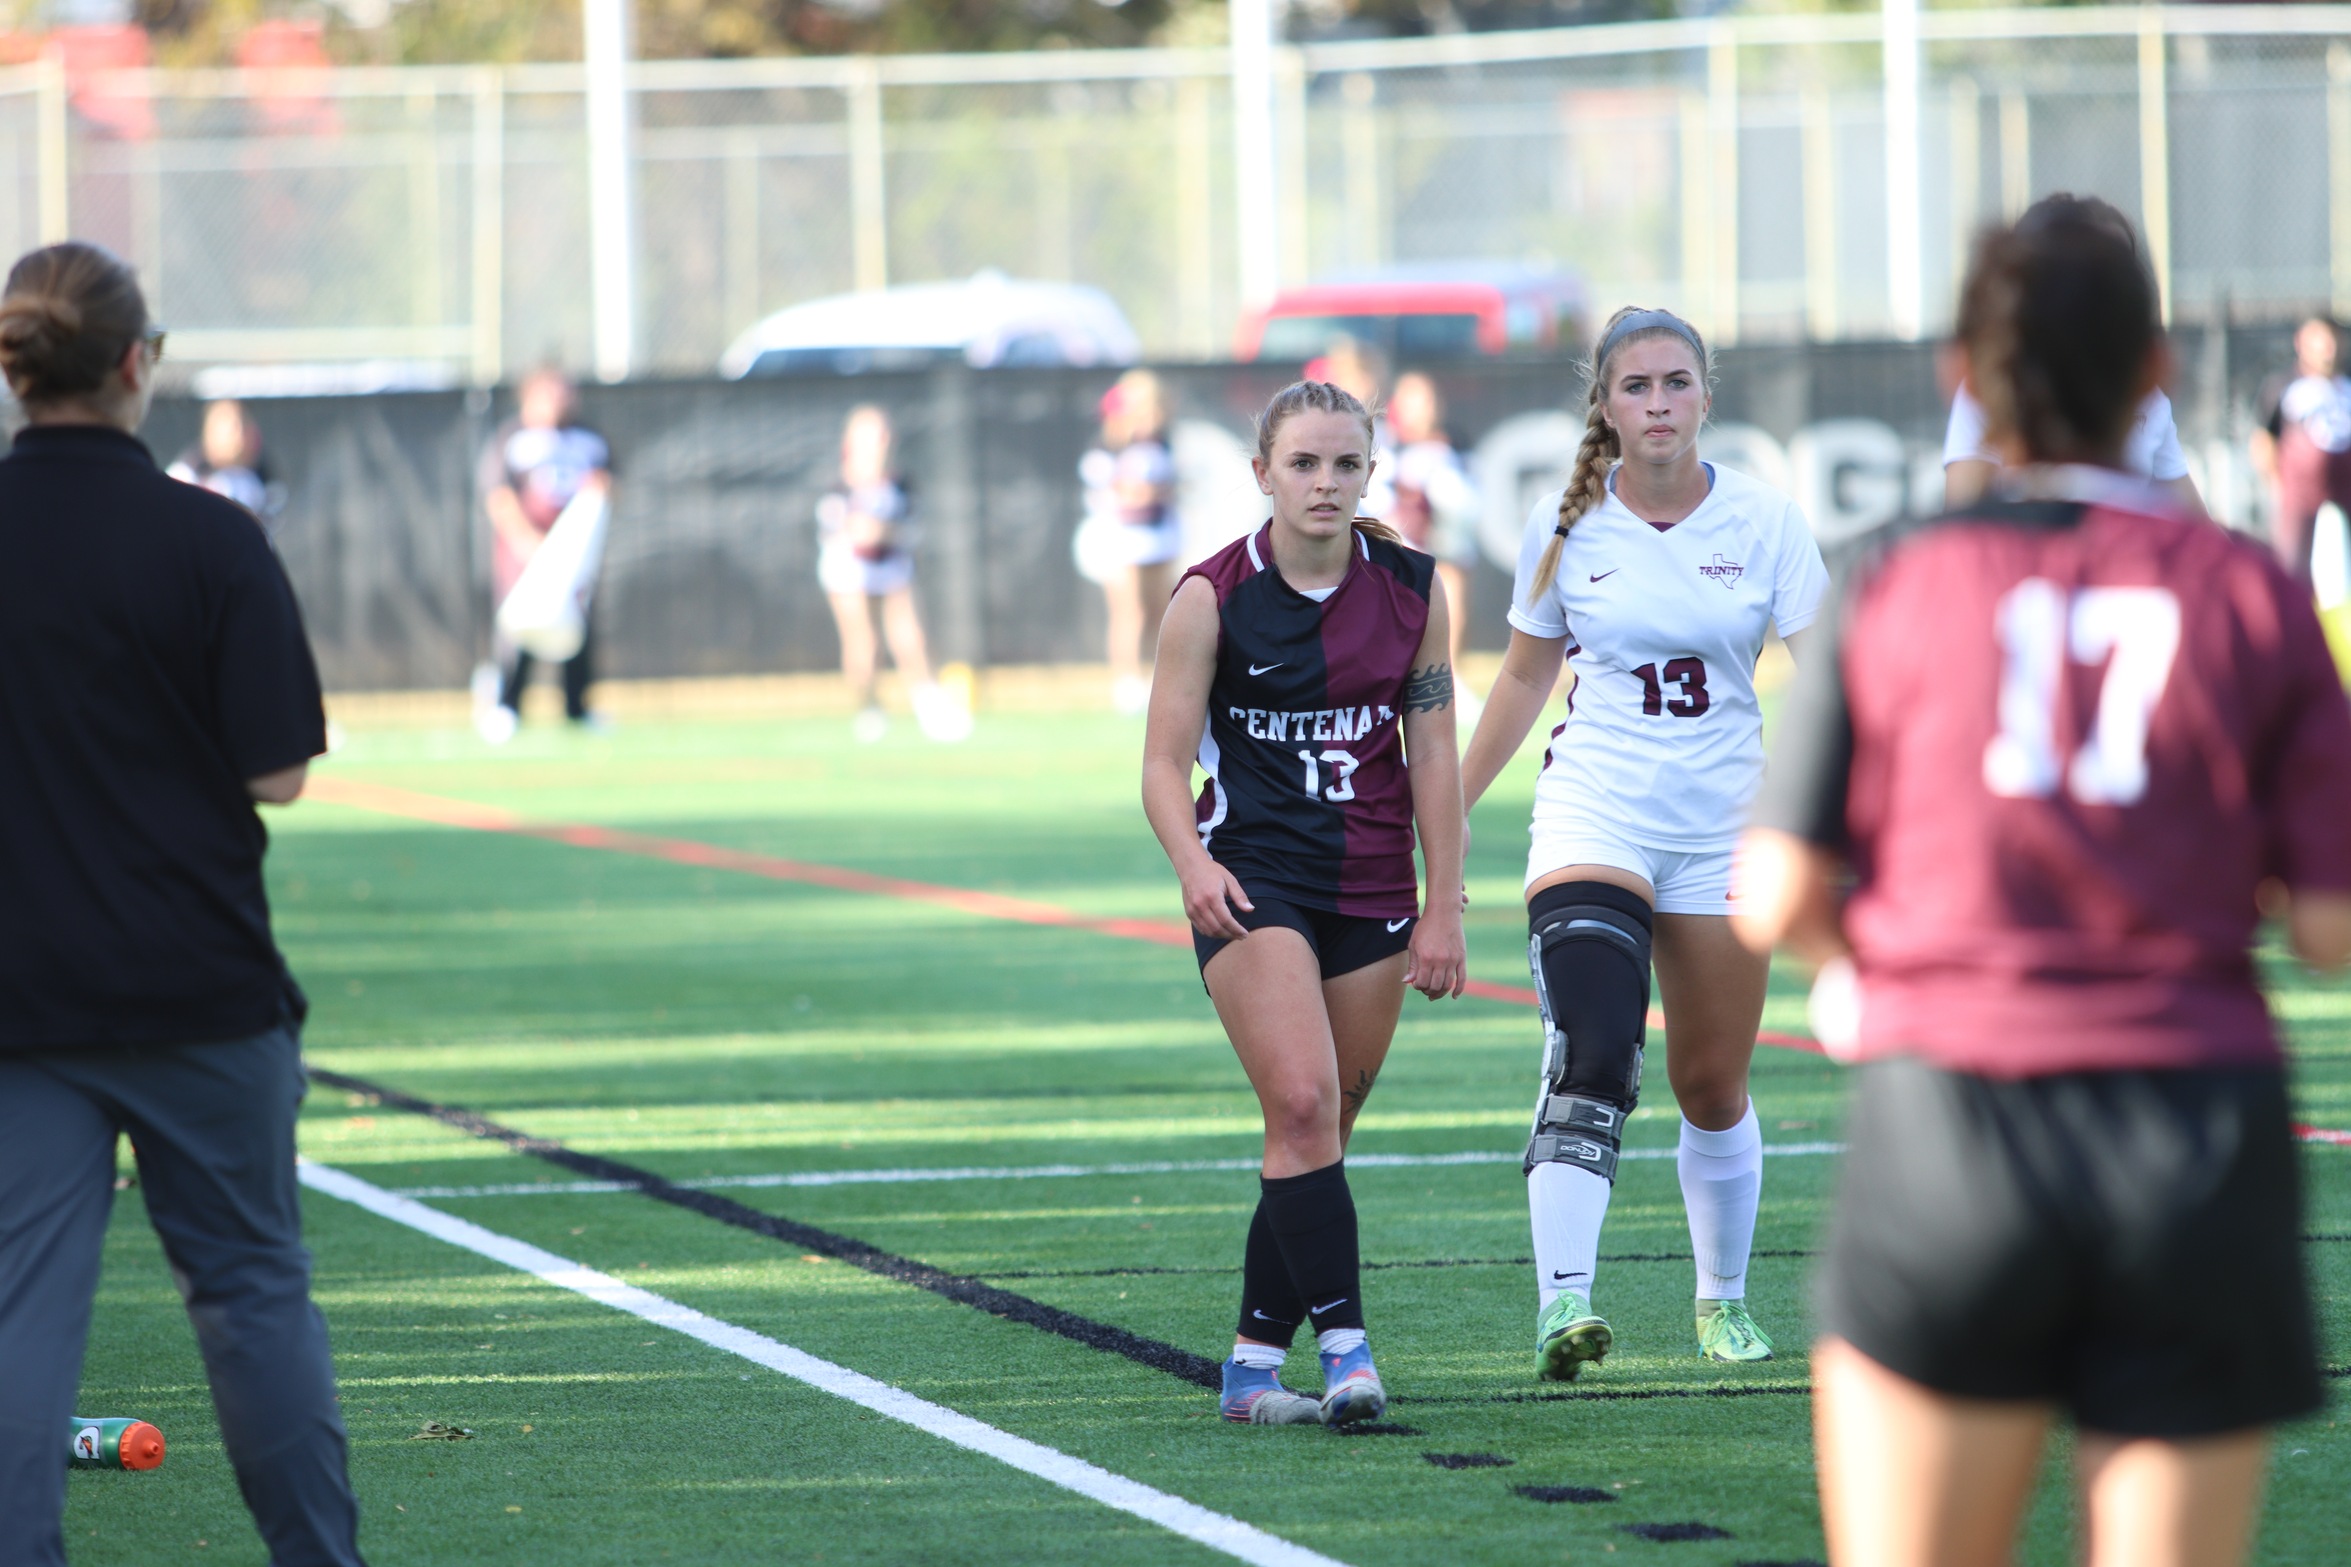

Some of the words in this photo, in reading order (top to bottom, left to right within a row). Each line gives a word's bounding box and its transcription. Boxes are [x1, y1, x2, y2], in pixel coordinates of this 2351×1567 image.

[1699, 565, 1744, 576] TRINITY
[1630, 656, 1711, 718] 13
[1982, 577, 2182, 806] 17
[1298, 749, 1360, 802] 13
